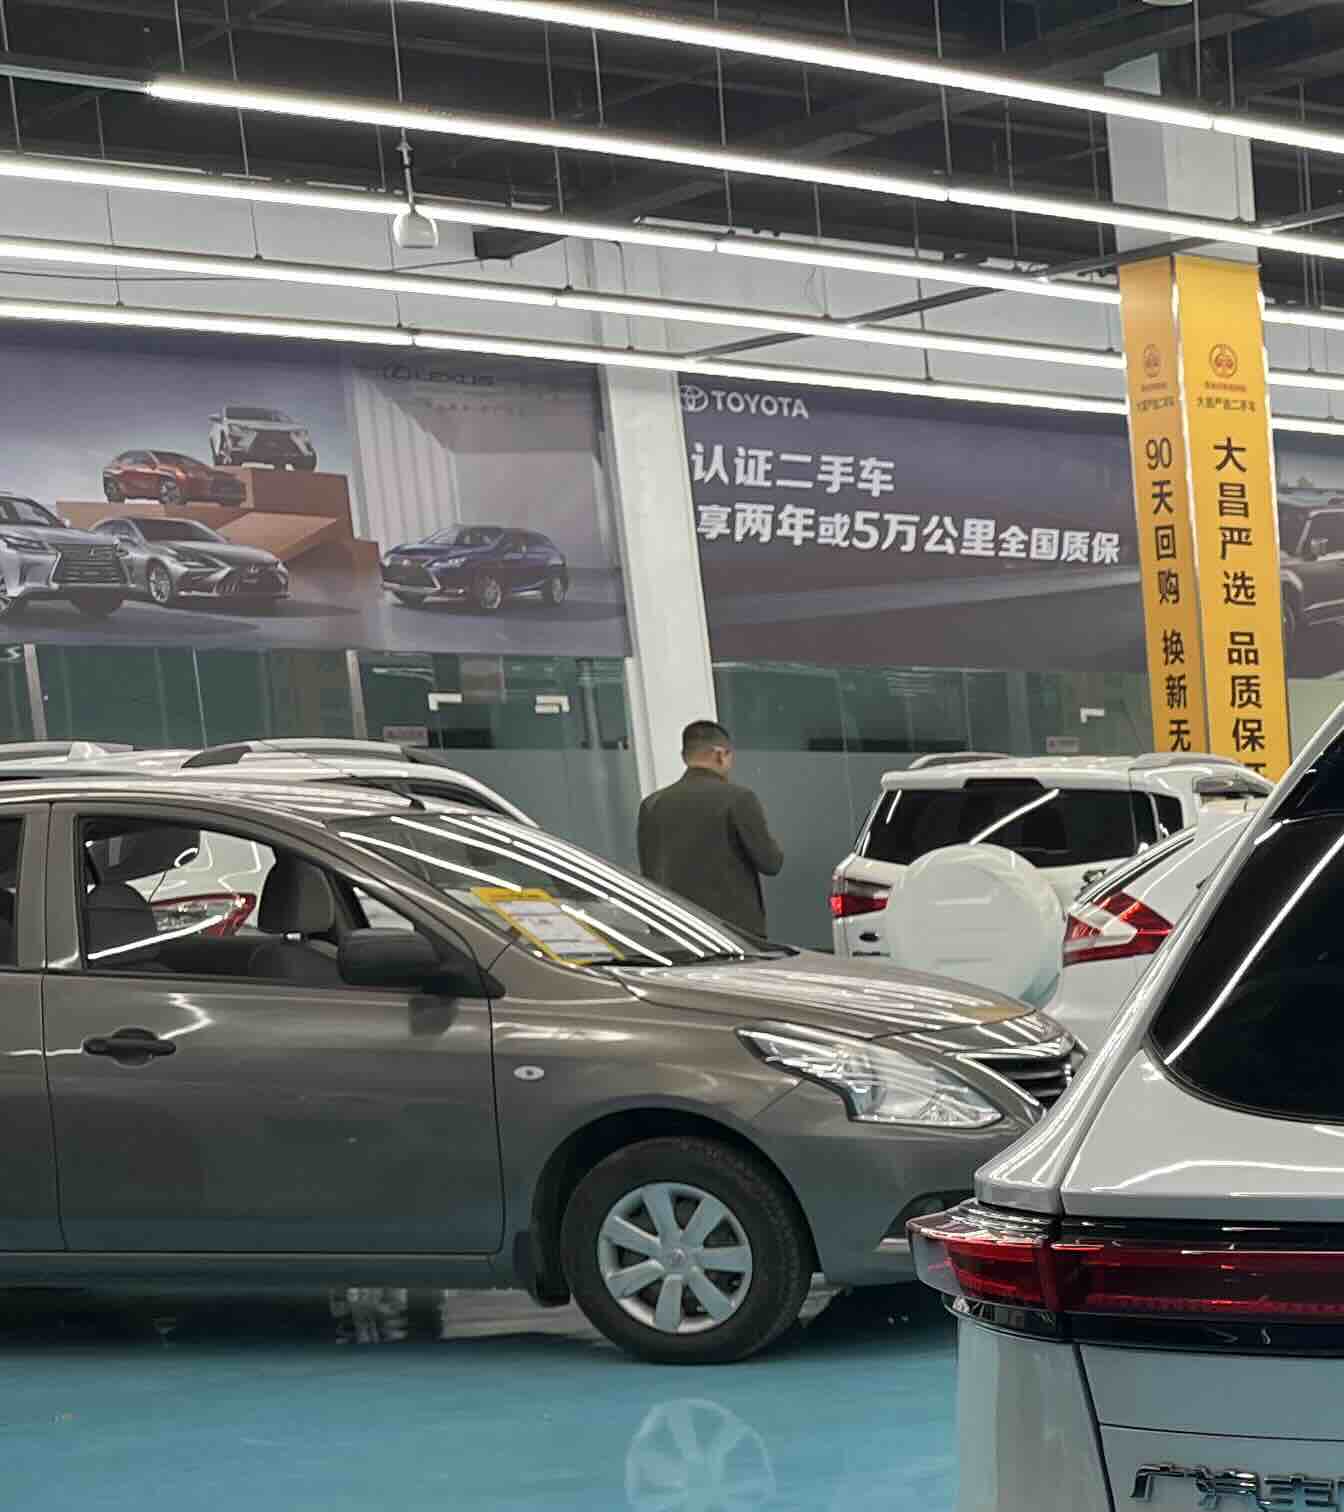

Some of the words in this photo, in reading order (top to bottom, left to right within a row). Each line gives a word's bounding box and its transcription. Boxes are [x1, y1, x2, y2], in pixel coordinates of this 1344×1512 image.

[711, 390, 809, 419] TOYOTA
[691, 442, 895, 498] 认证二手车
[697, 502, 1121, 563] 享两年或5万公里全国质保
[1145, 437, 1180, 606] 90天回购
[1213, 436, 1257, 607] 大昌严选
